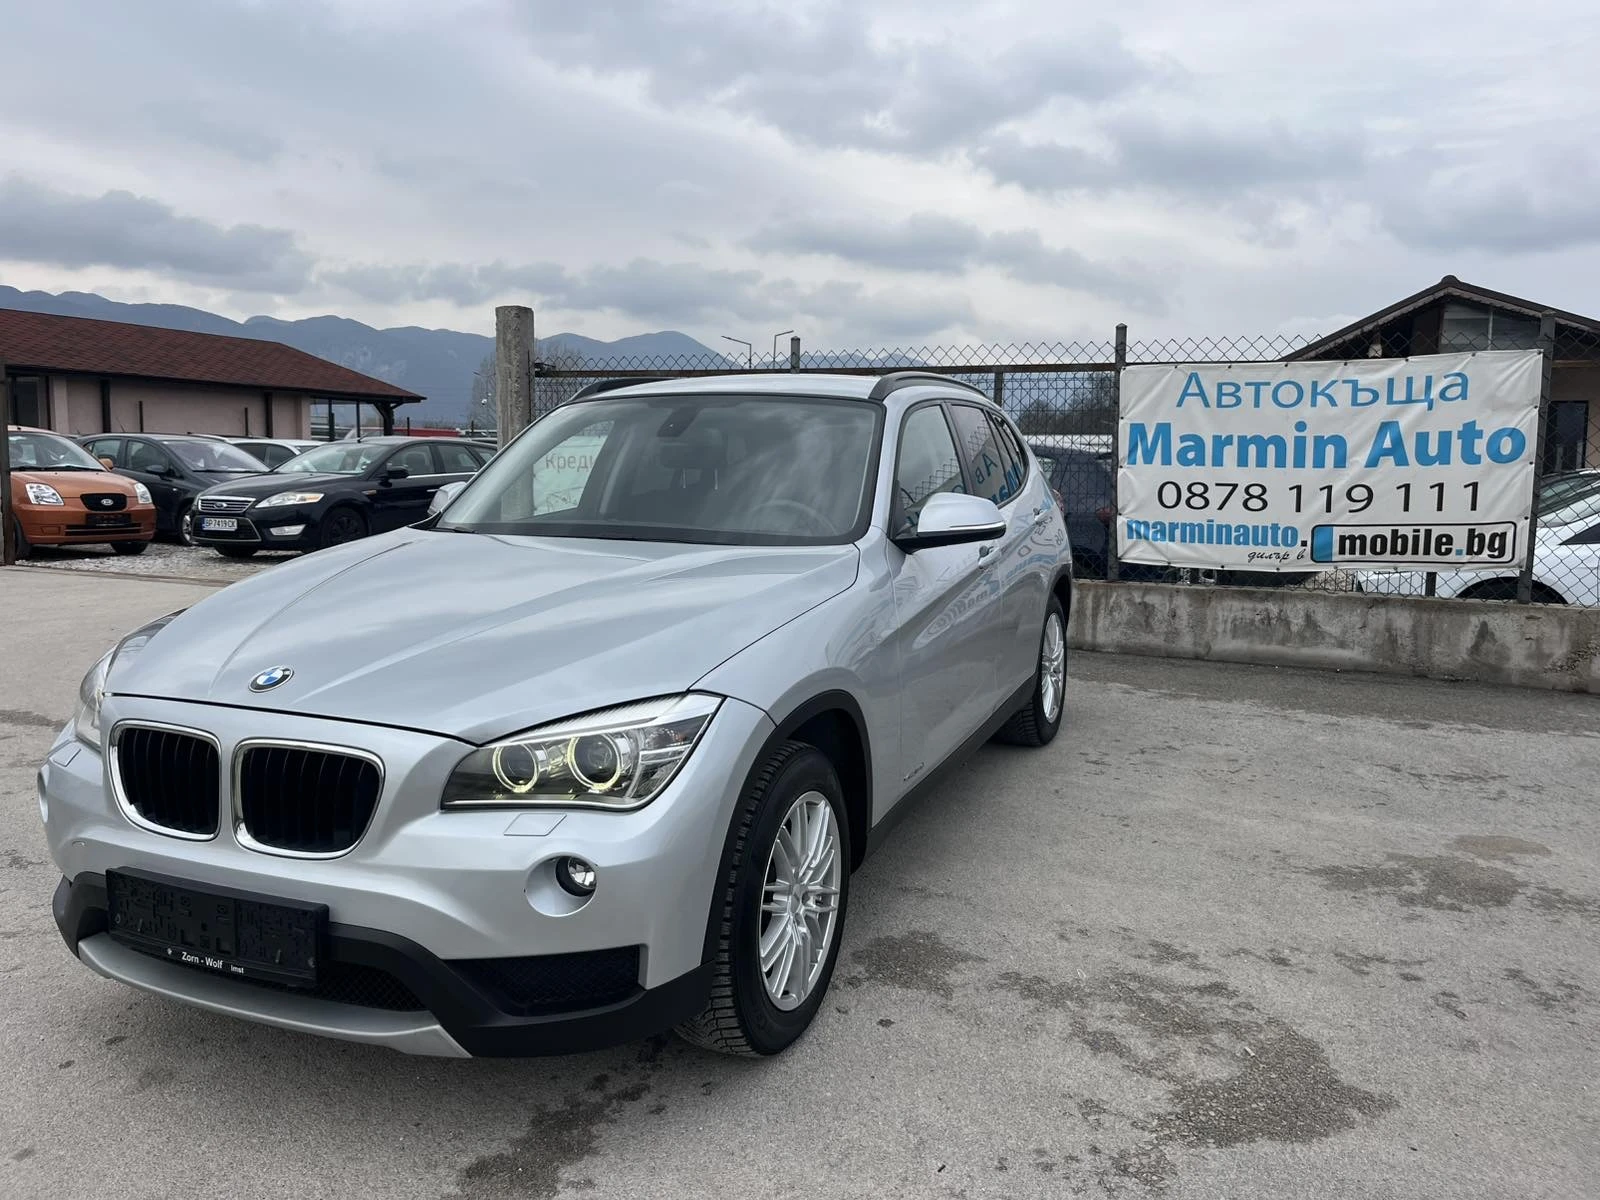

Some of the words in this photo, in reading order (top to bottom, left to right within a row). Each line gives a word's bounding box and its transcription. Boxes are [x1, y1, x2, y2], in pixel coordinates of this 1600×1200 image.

[1176, 371, 1470, 411] Автокъща
[1127, 420, 1349, 469] Marmin
[1364, 419, 1527, 469] Auto
[1157, 480, 1269, 512] 0878
[1288, 483, 1374, 514] 119
[1396, 481, 1479, 513] 111
[1338, 527, 1508, 559] mobile.bg
[181, 951, 200, 964] Zorn
[204, 956, 224, 969] Wolf
